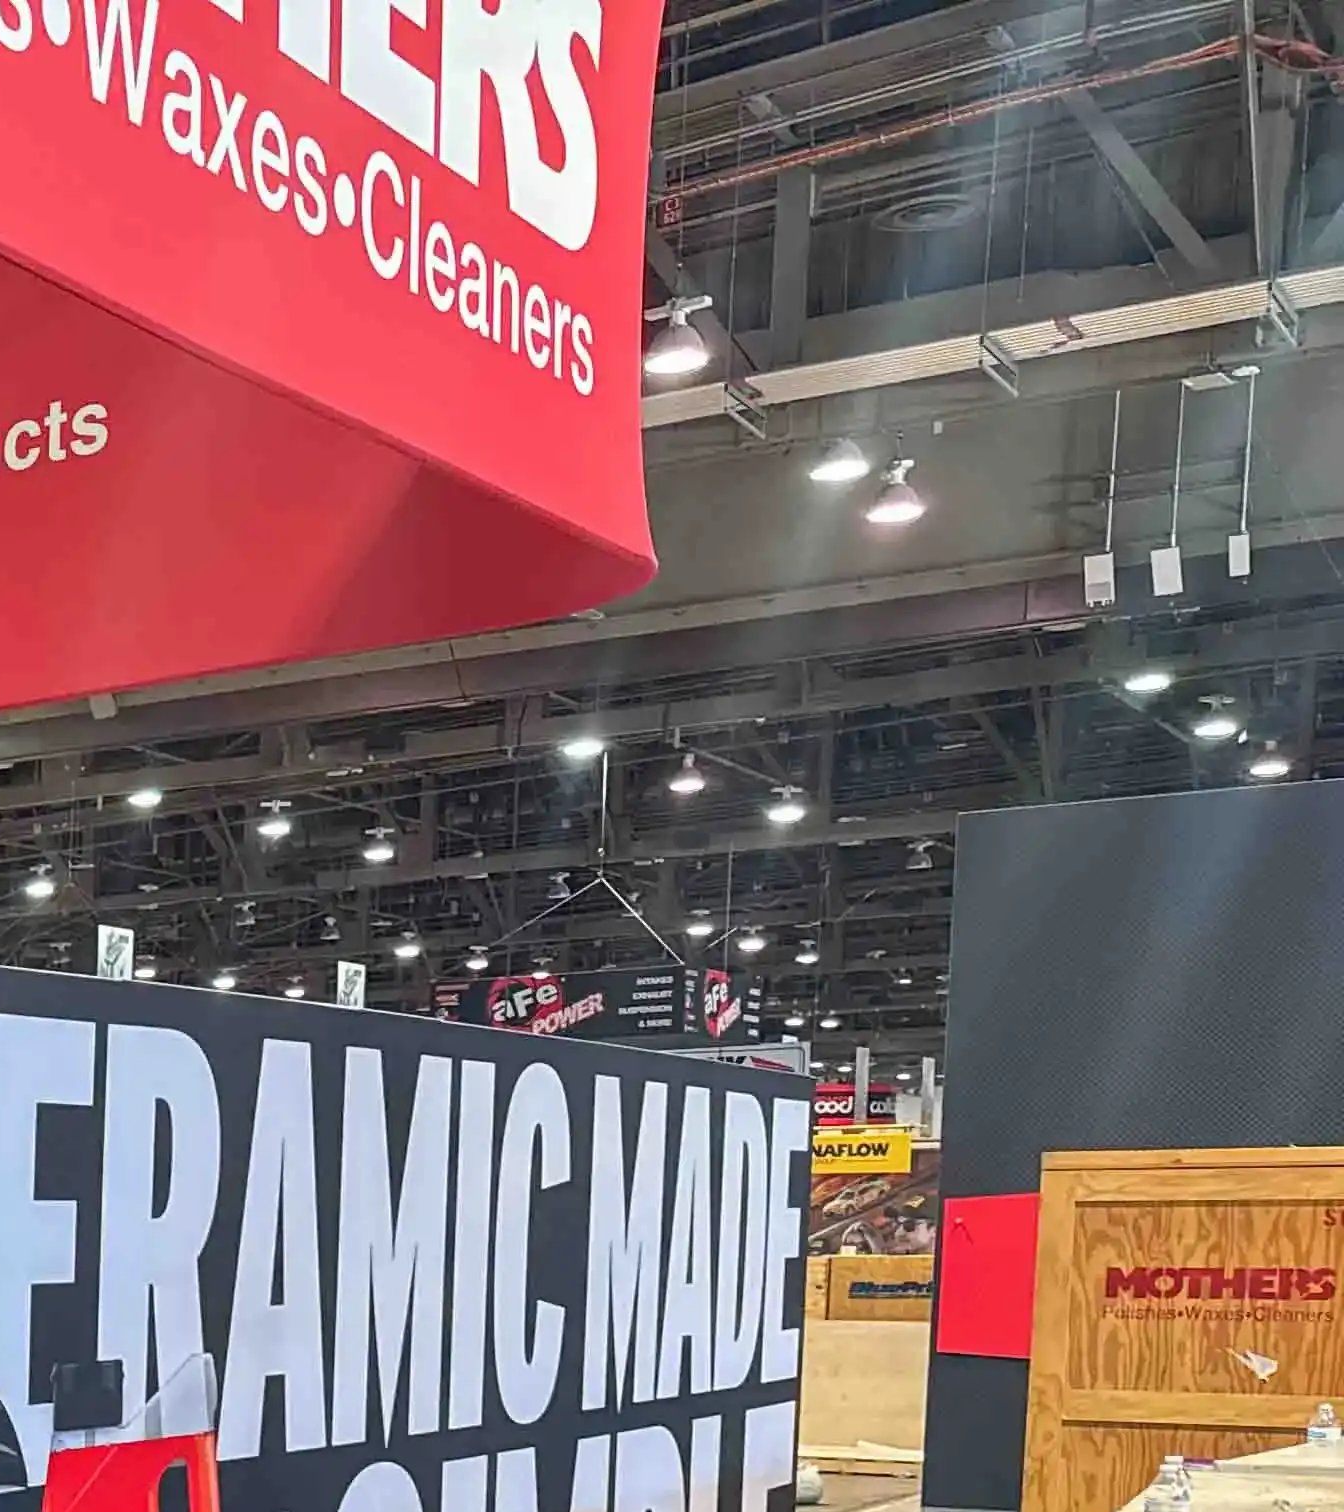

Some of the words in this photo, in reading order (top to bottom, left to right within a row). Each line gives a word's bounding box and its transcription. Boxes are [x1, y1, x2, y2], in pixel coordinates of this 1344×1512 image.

[531, 992, 605, 1034] POWER
[581, 1073, 811, 1410] MADE
[1104, 1266, 1337, 1300] MOTHERS
